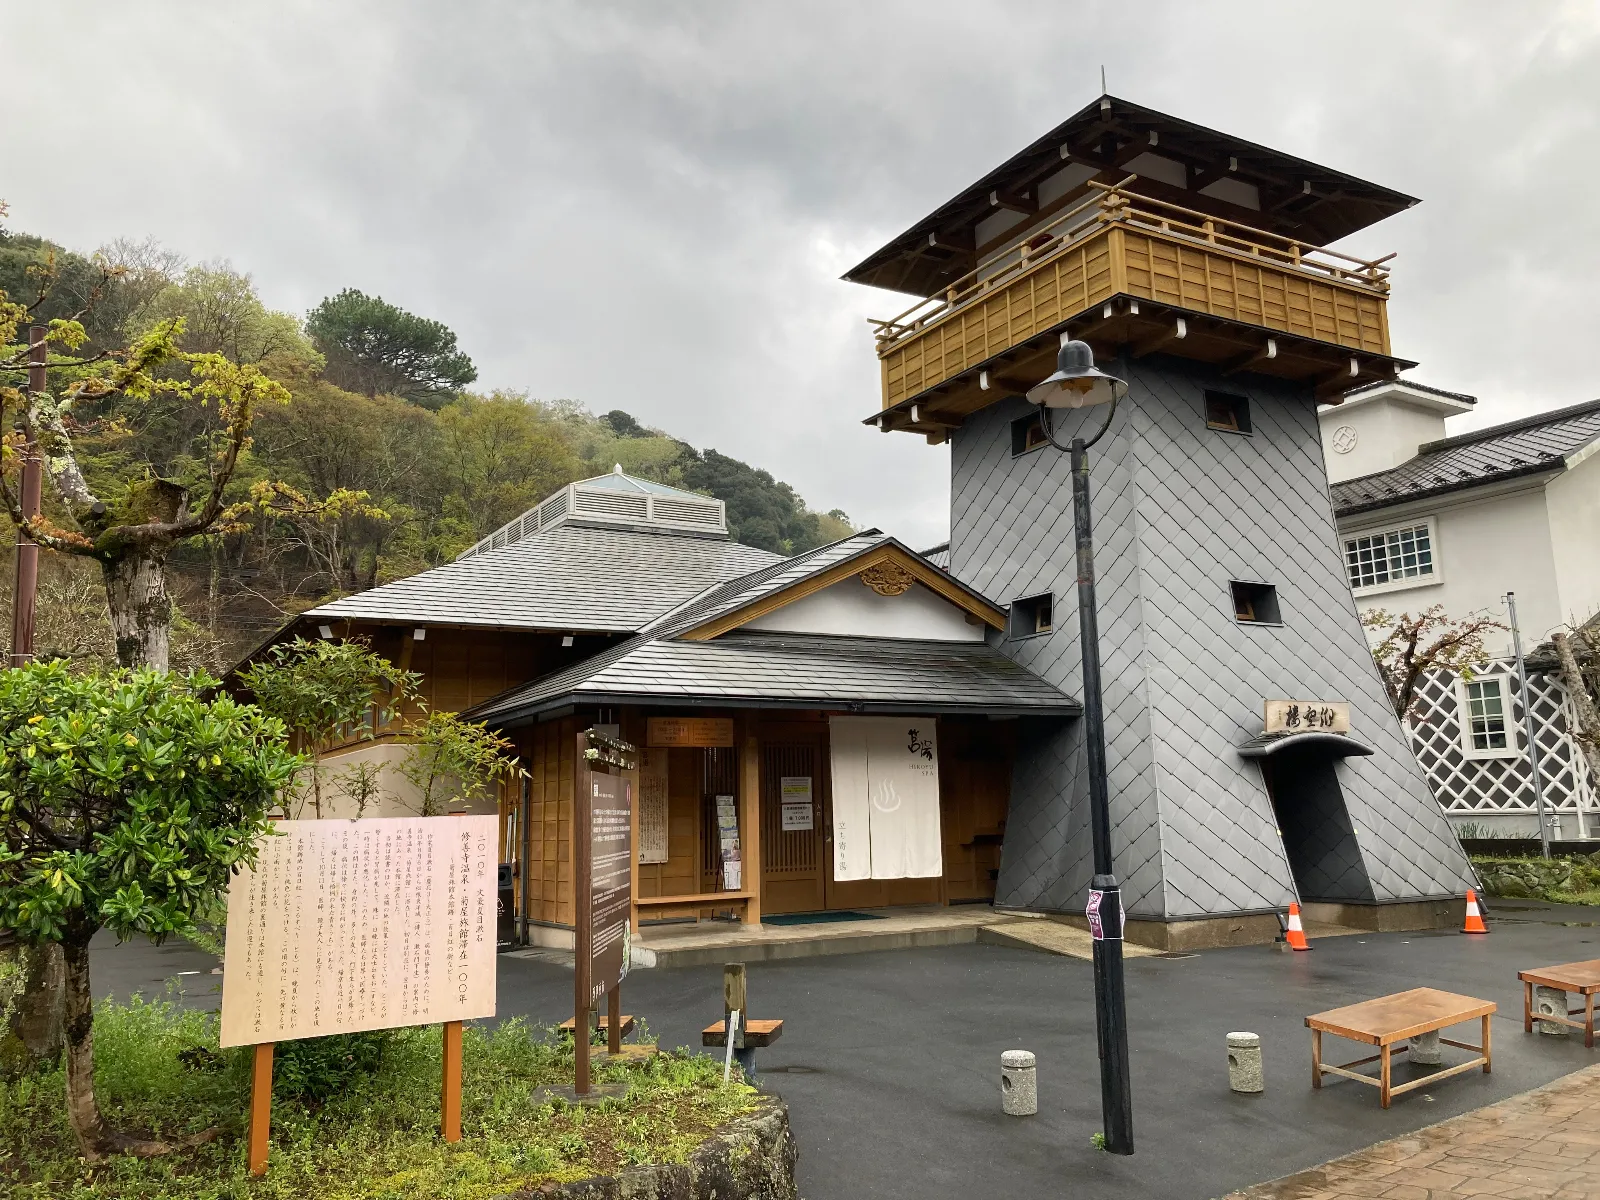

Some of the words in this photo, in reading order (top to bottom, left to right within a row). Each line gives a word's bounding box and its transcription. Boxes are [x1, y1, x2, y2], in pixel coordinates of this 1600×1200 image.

[816, 803, 821, 817] 入口
[838, 820, 848, 872] 立ち寄り湯
[474, 887, 485, 943] 文豪夏目漱石
